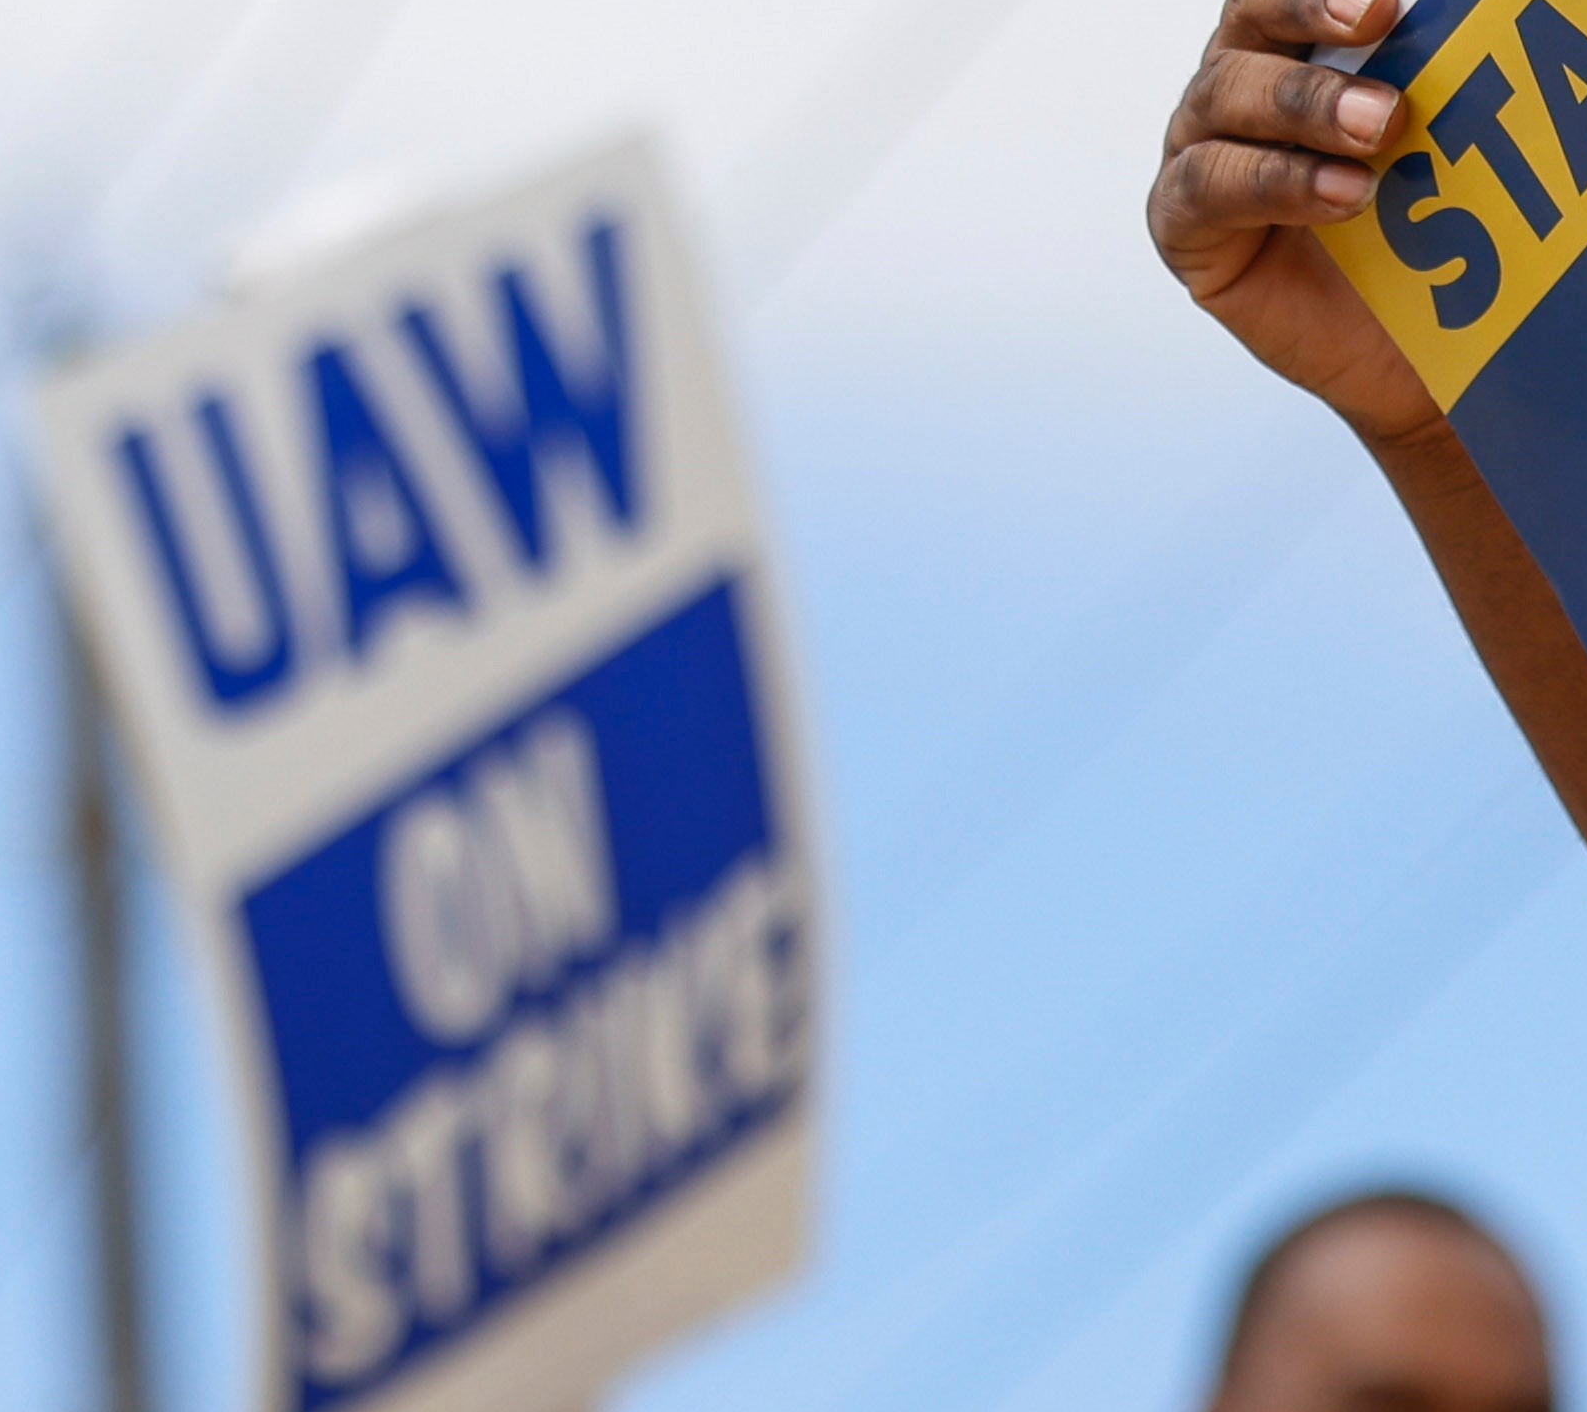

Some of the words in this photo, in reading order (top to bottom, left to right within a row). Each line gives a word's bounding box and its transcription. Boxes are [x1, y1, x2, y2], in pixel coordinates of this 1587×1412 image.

[106, 207, 659, 729] UAW
[288, 839, 811, 1385] STRIKE
[379, 701, 617, 1047] ON
